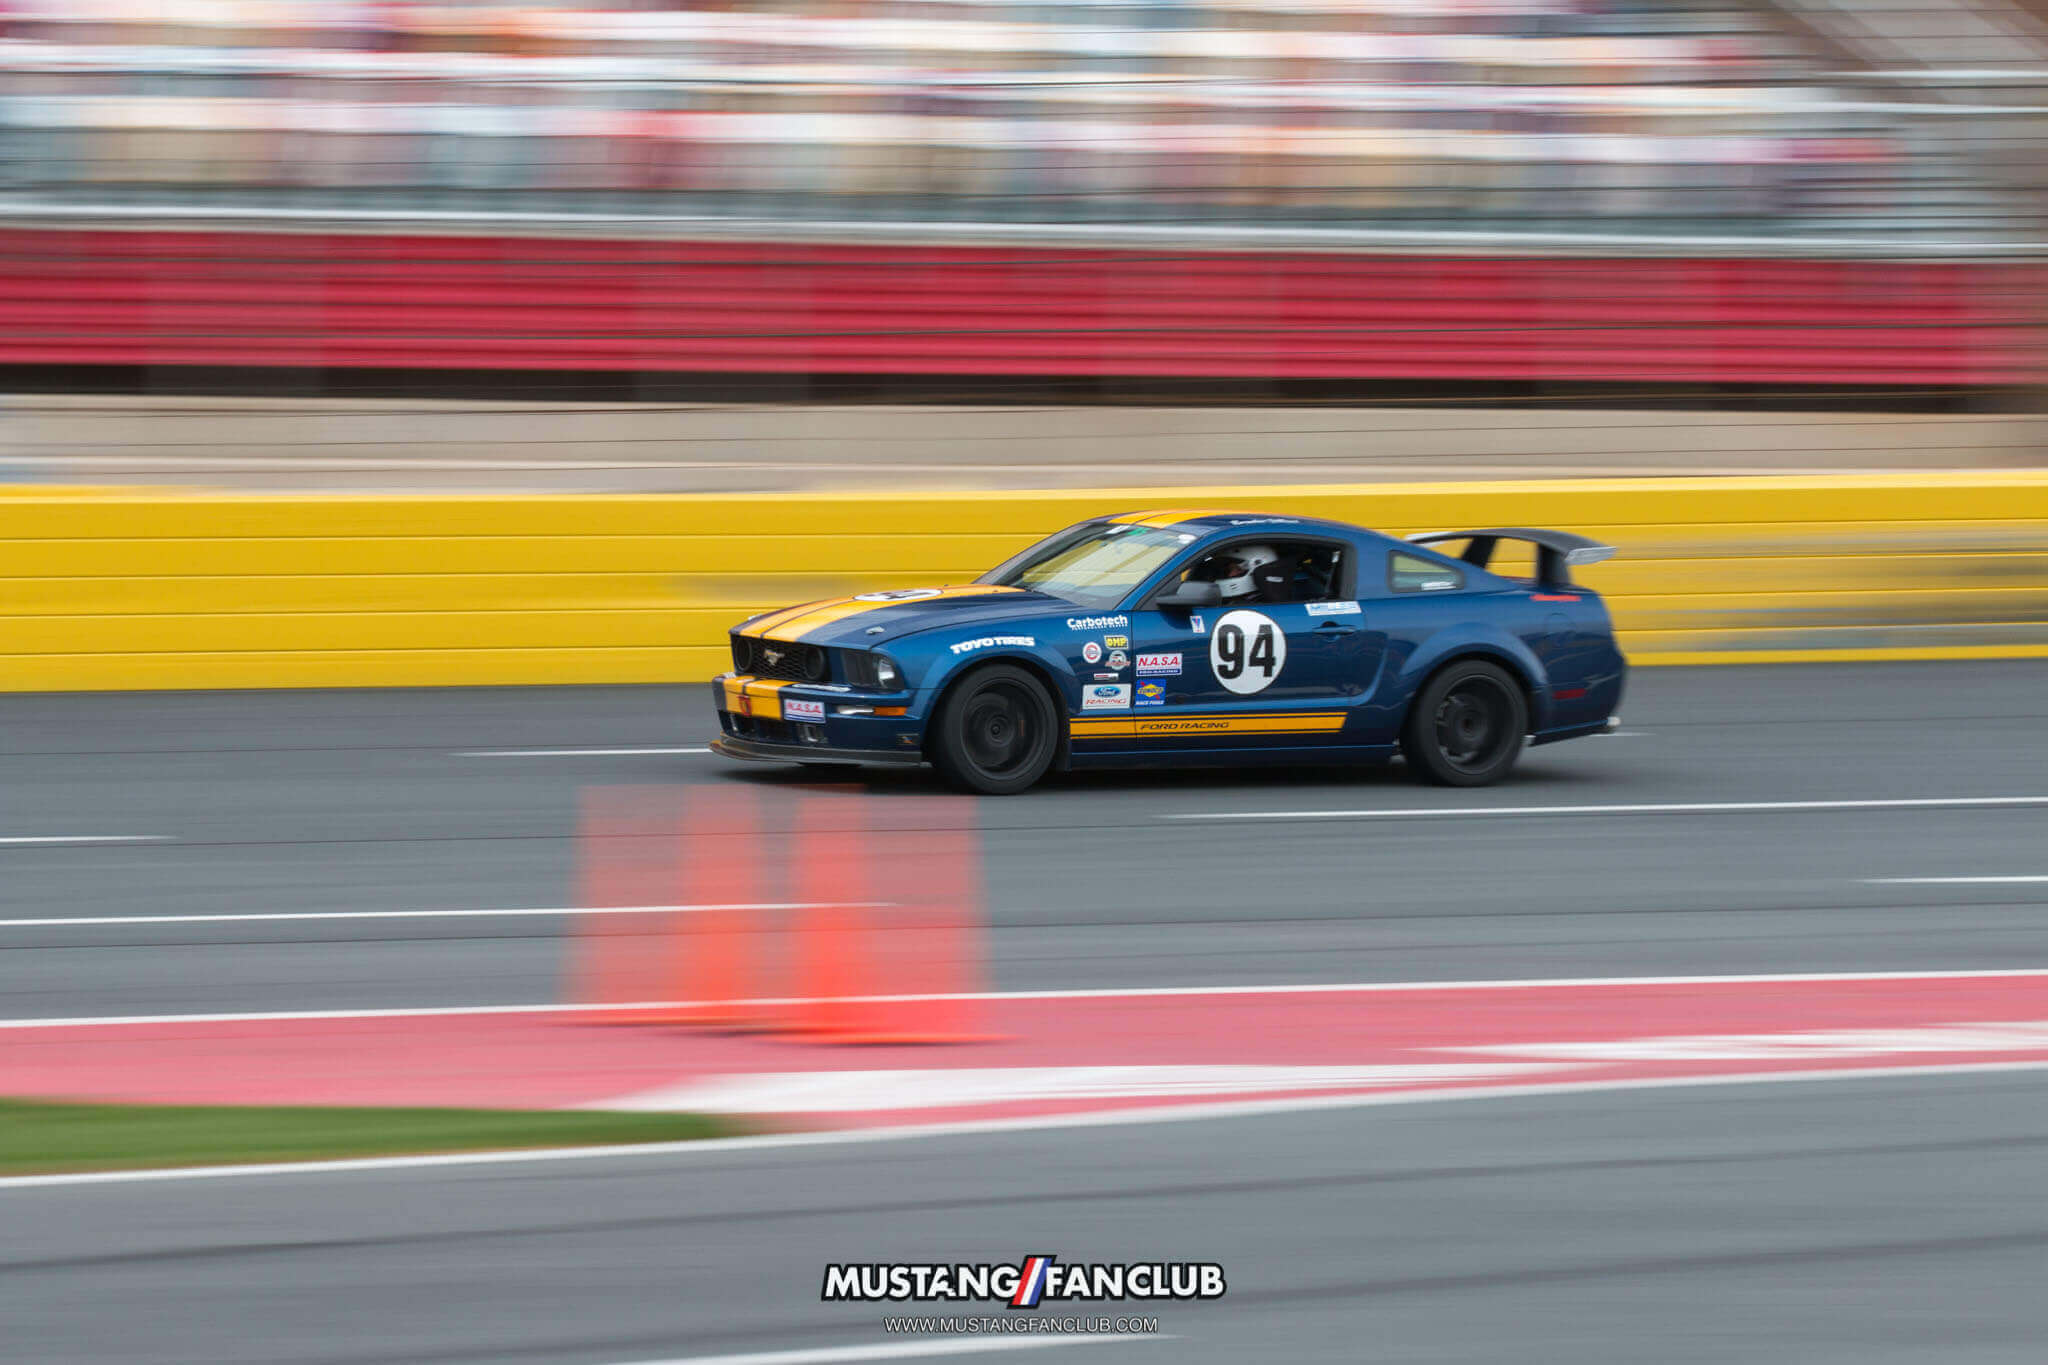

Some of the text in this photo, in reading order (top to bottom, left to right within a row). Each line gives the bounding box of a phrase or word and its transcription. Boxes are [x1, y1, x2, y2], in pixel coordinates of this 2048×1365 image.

[1067, 615, 1128, 629] Carbotech
[950, 636, 1035, 654] TOYO TIRES
[1217, 624, 1276, 680] 94
[1097, 686, 1117, 697] Ford
